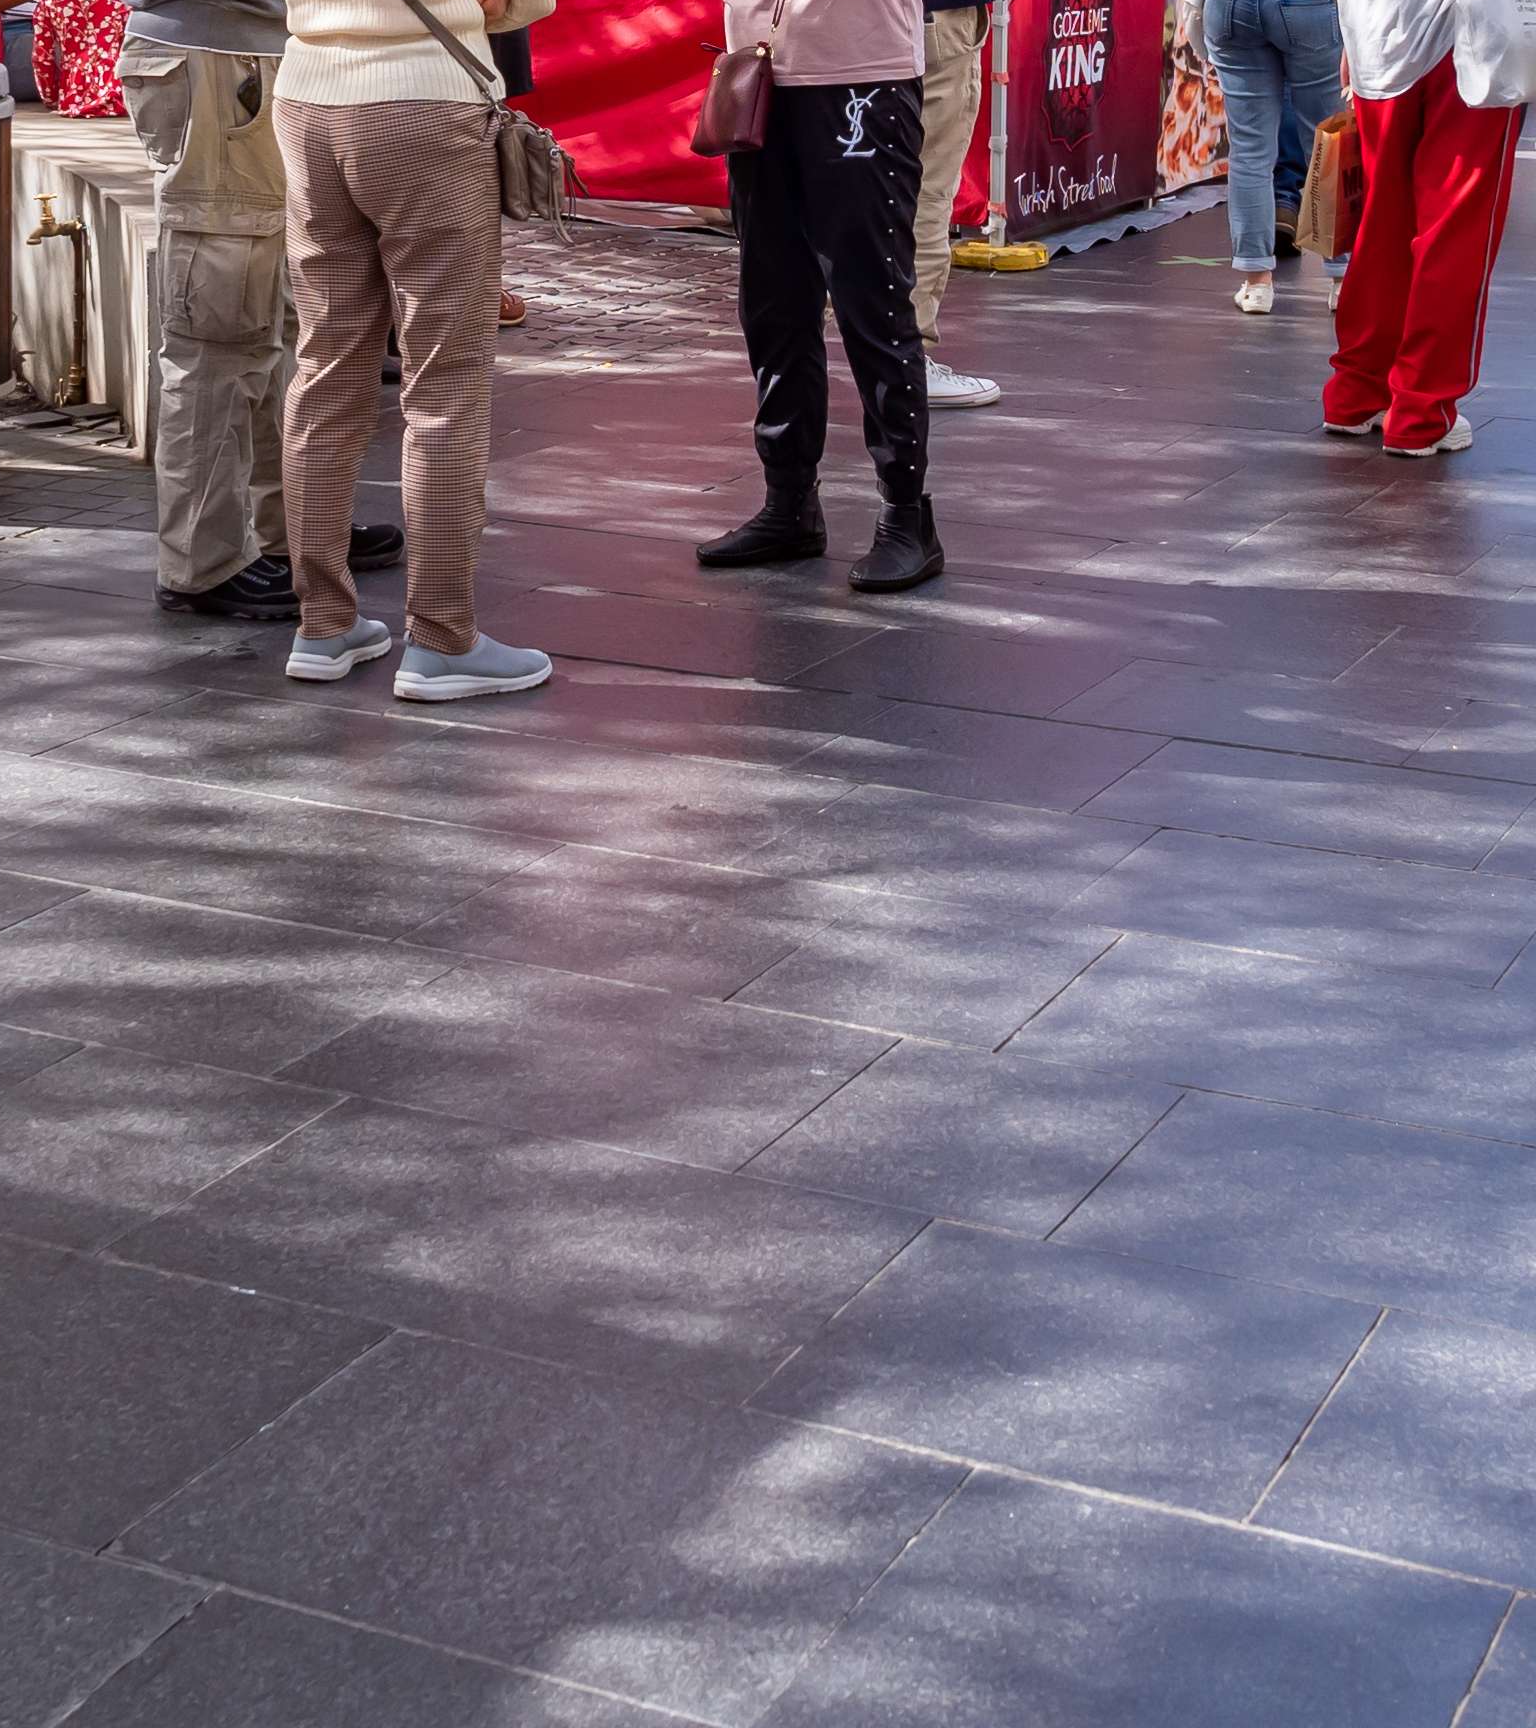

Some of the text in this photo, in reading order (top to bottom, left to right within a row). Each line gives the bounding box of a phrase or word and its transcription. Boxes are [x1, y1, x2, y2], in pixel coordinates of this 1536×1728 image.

[1053, 6, 1110, 40] GÖZLEME
[1048, 40, 1106, 91] KING
[1014, 165, 1057, 218] Turkish
